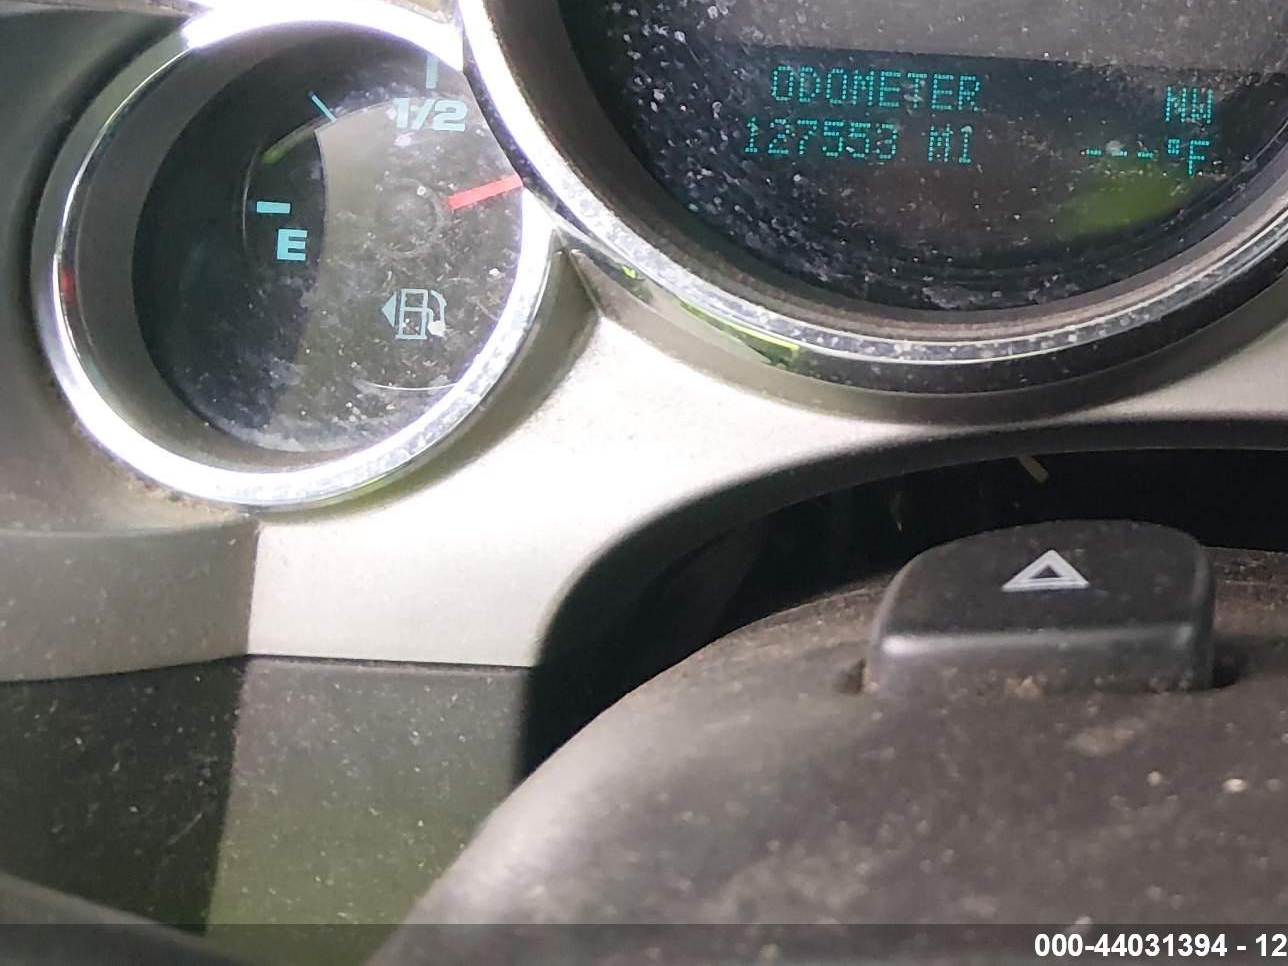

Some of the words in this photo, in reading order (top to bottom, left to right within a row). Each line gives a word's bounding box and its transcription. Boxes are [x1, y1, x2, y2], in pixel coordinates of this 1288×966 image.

[771, 65, 981, 111] ODOMETER
[1165, 85, 1215, 124] NW
[394, 96, 469, 132] 1/2
[745, 117, 898, 159] 127553
[277, 228, 308, 262] E
